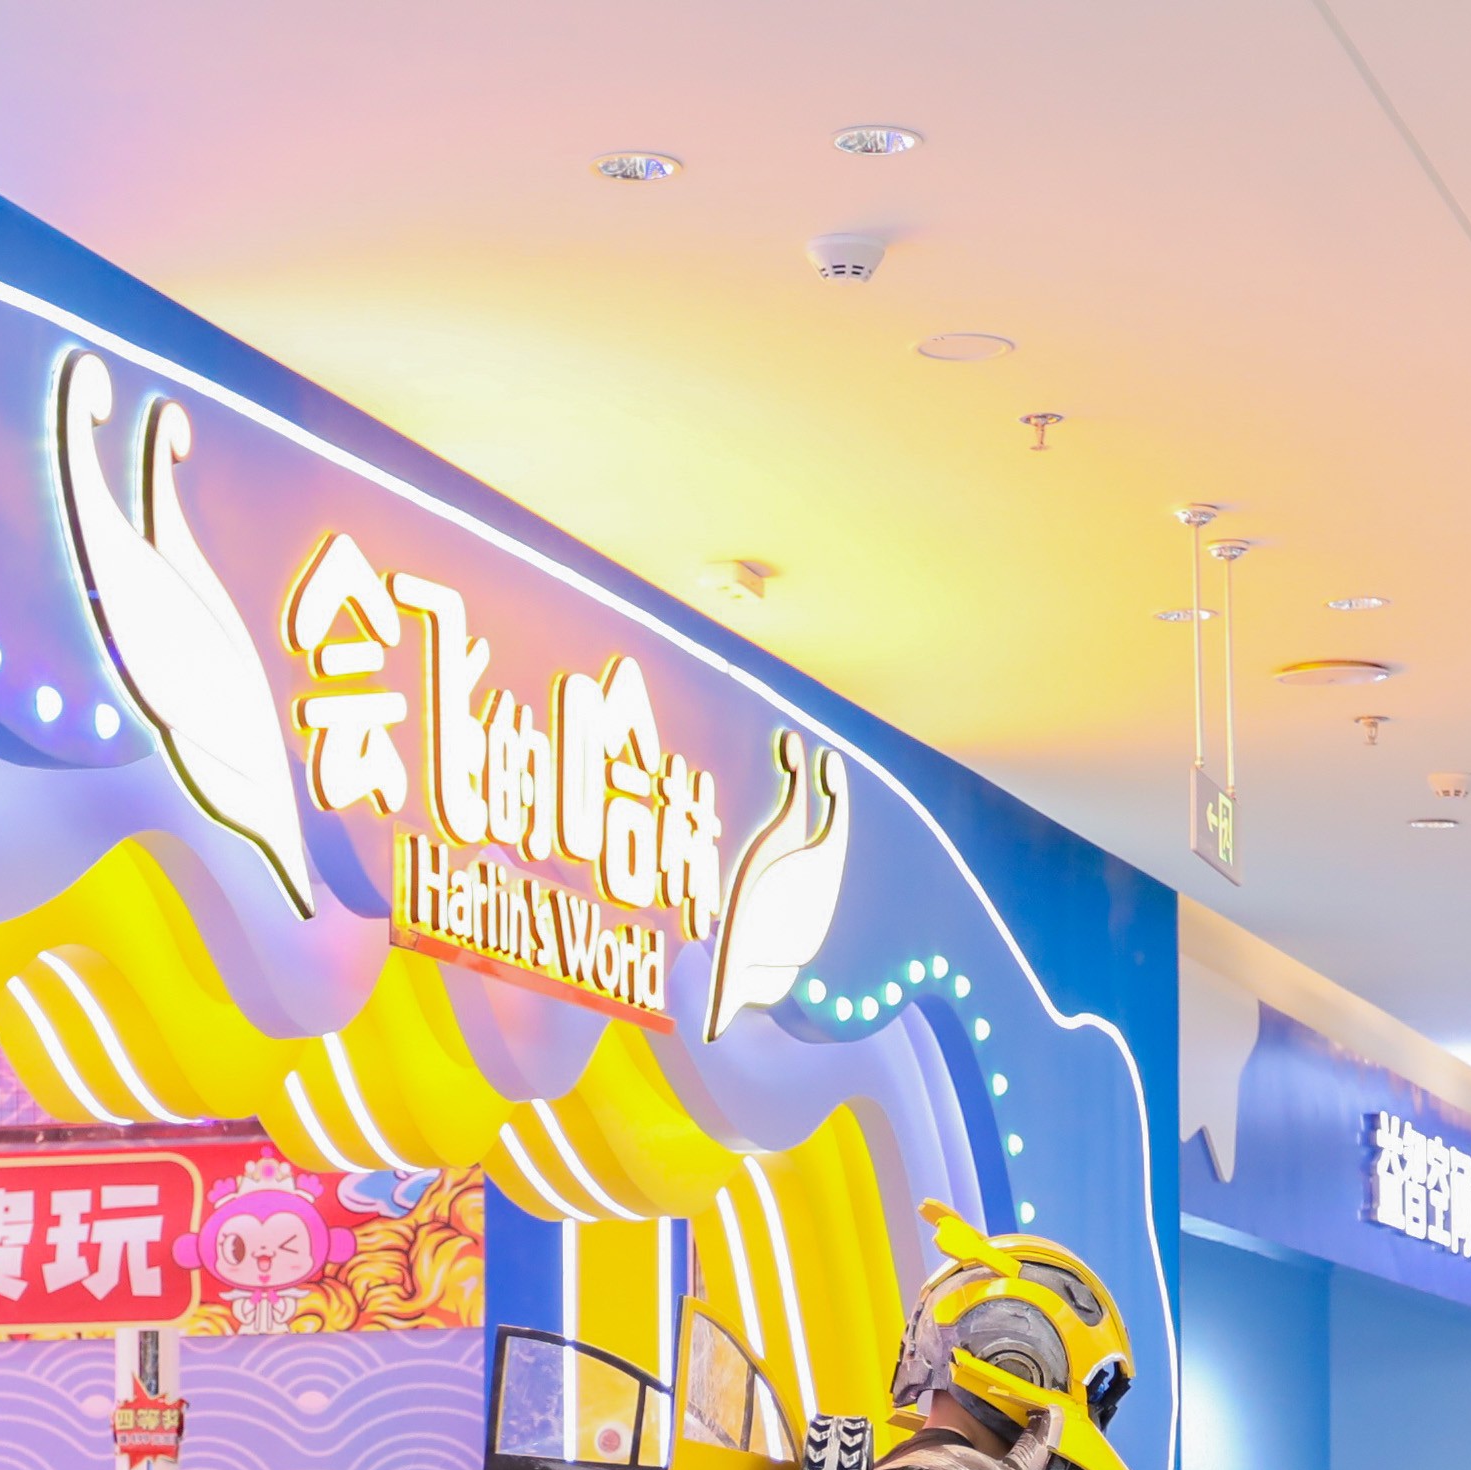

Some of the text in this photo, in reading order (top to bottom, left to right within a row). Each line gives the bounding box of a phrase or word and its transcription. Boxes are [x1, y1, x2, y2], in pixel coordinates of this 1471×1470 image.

[281, 532, 722, 941] 会飞的哈林
[403, 833, 668, 1013] Harlin's World
